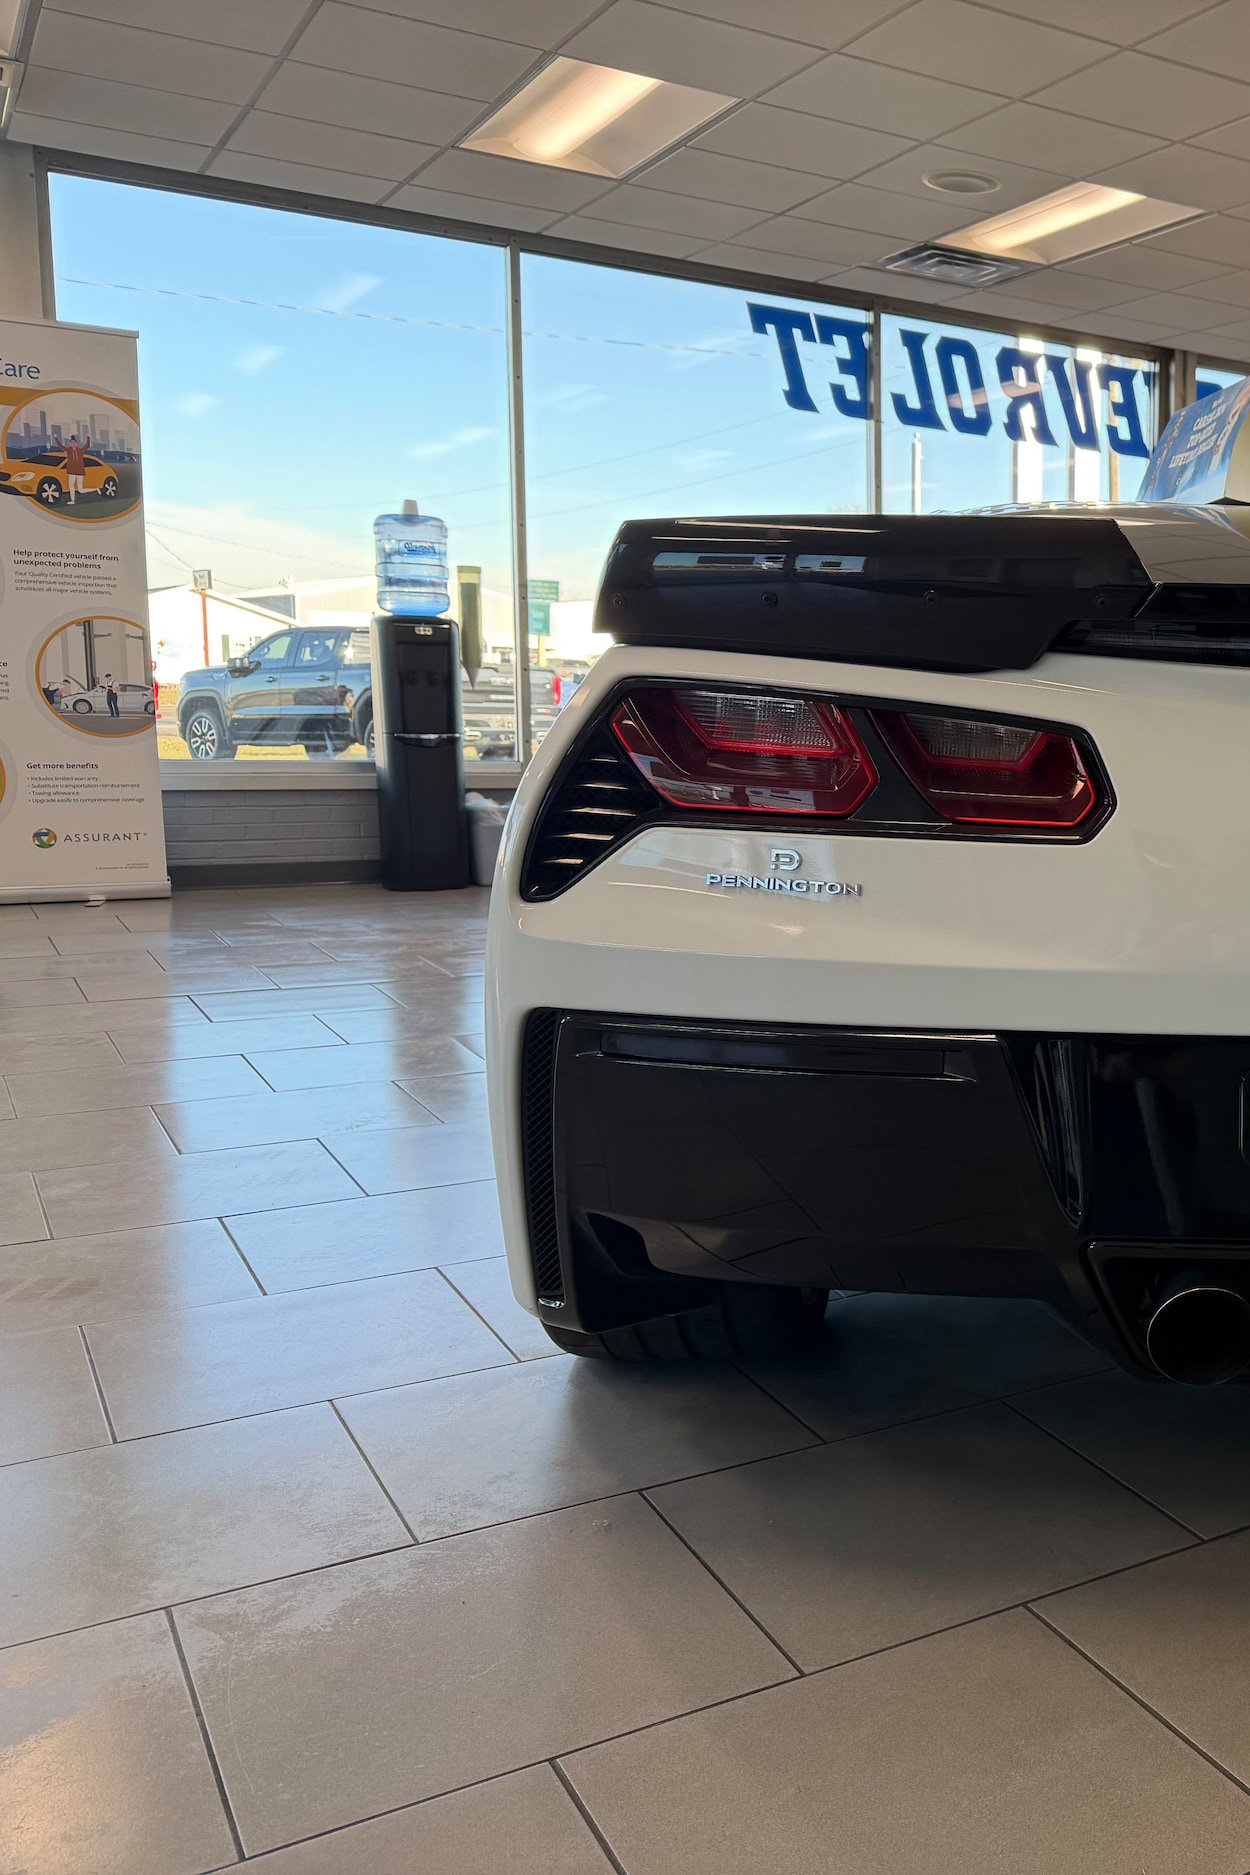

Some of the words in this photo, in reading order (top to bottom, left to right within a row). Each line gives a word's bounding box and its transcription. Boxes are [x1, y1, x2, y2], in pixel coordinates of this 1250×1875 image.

[13, 549, 32, 557] Help
[34, 550, 64, 559] protect
[65, 552, 98, 561] yourself
[13, 559, 61, 567] unexpected
[63, 561, 101, 569] problems
[28, 571, 48, 579] Quality
[26, 762, 41, 770] Get
[66, 762, 99, 770] benefits
[705, 873, 862, 897] PENNINGTON
